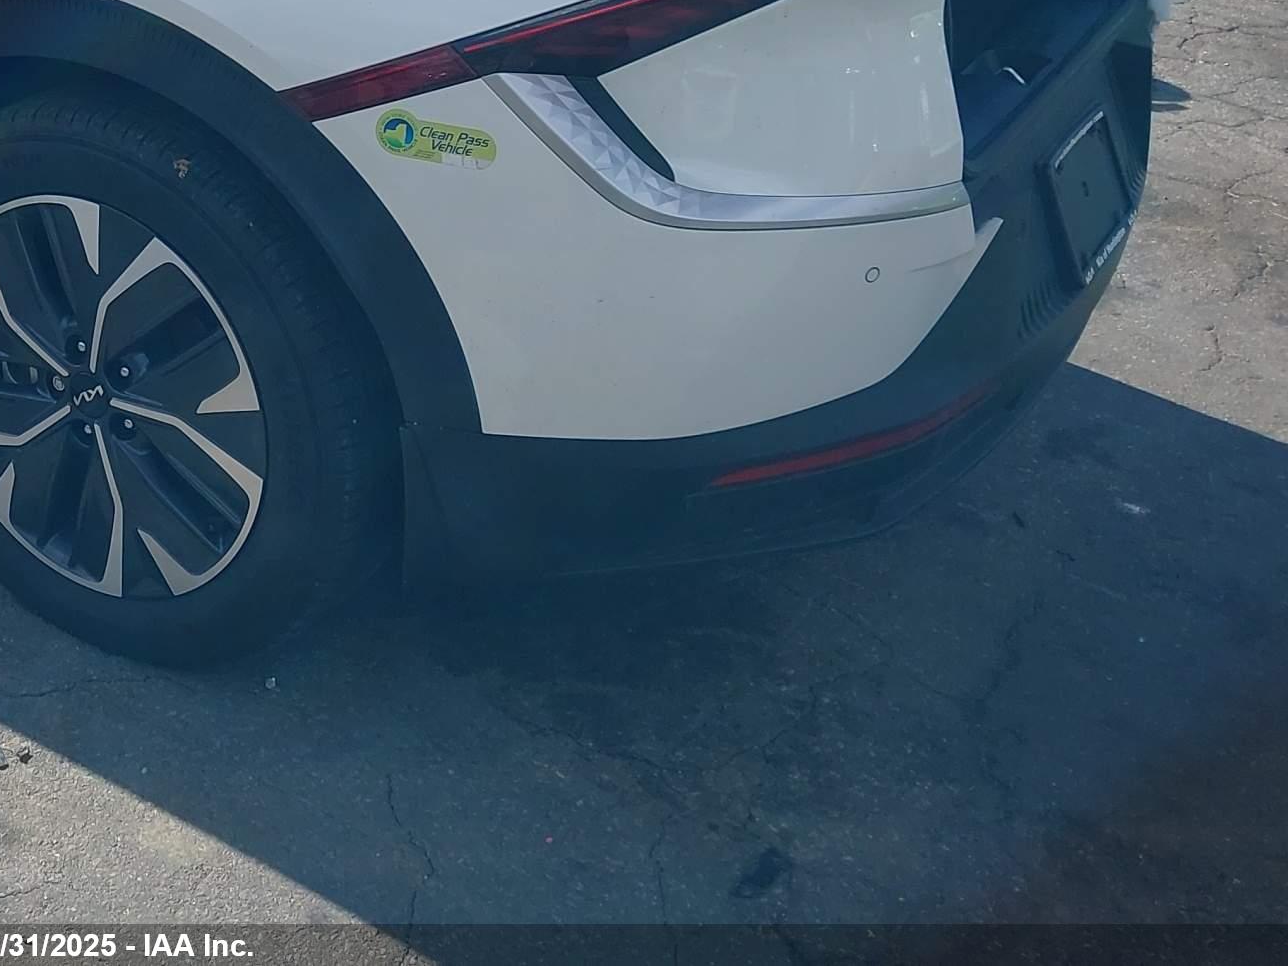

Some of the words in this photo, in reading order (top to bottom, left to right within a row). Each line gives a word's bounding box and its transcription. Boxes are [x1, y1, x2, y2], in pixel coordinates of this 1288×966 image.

[420, 126, 454, 142] Clean
[457, 132, 491, 148] Pass
[431, 139, 474, 157] Vehicle
